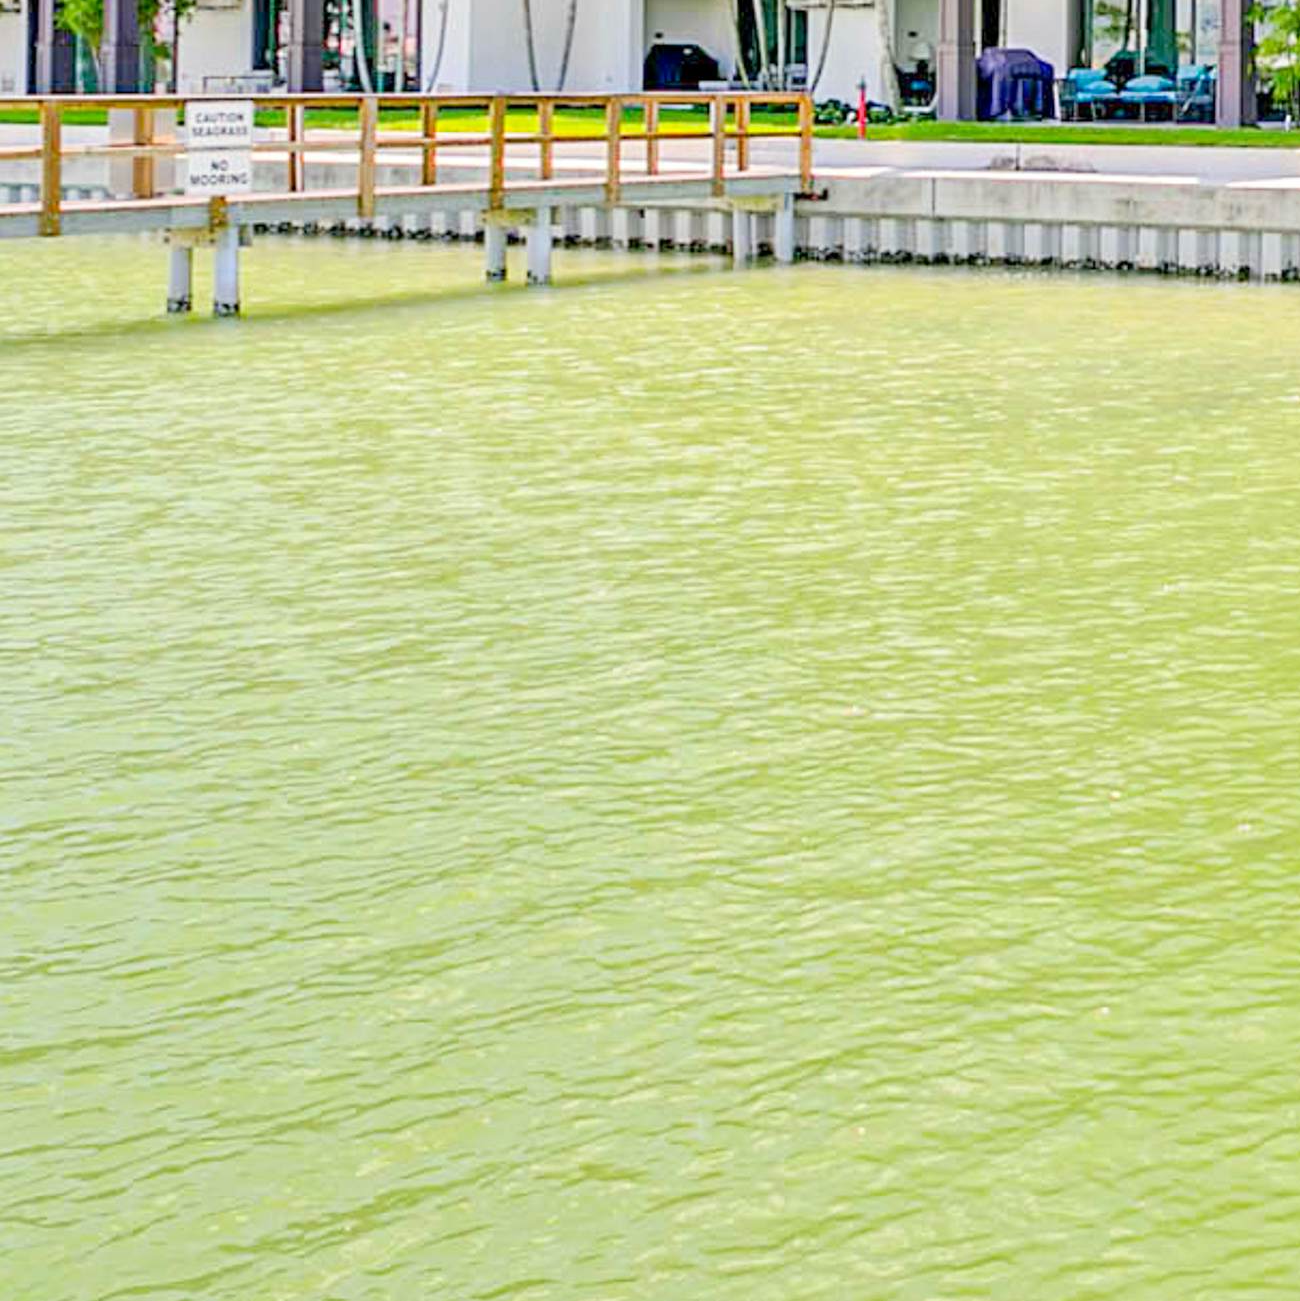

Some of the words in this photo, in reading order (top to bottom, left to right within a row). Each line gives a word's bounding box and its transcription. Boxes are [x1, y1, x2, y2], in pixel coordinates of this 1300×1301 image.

[195, 112, 244, 123] CAUTION
[192, 127, 248, 137] SEAGRASS
[210, 159, 229, 172] NO
[190, 172, 248, 186] MOORING
